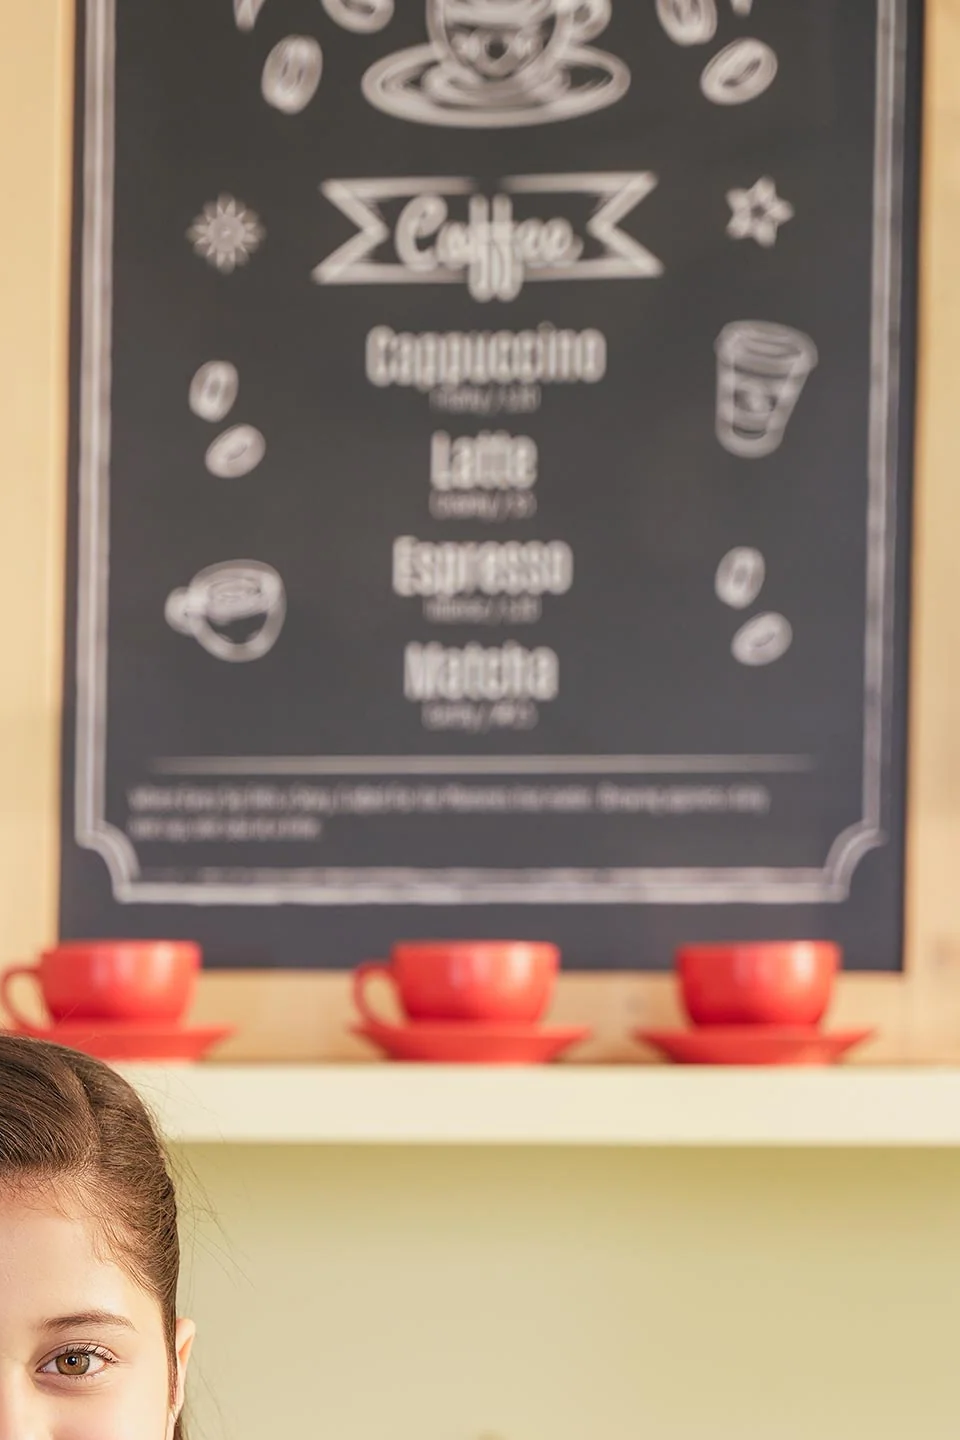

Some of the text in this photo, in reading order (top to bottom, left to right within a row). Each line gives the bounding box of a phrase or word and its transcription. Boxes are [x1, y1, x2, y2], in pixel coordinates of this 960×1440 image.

[396, 193, 583, 302] Coffee
[366, 319, 606, 390] Cappuccino
[431, 430, 538, 491] Latte
[393, 536, 573, 599] Espresso
[404, 640, 559, 701] Matcha
